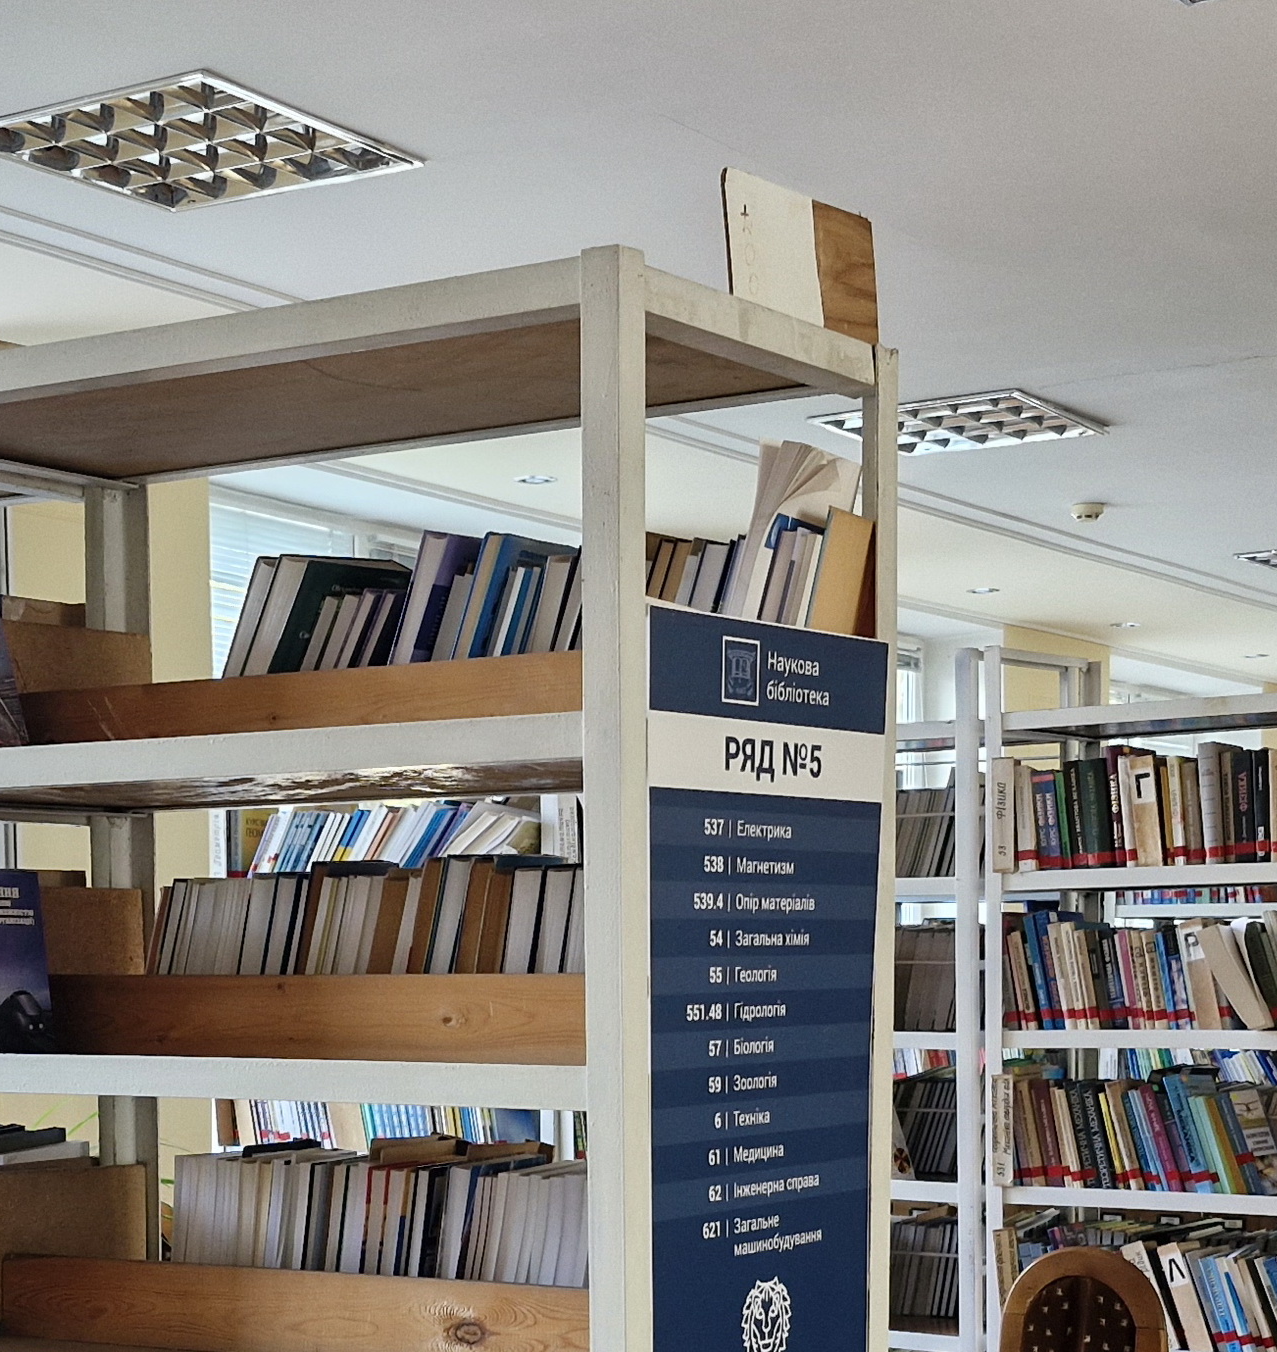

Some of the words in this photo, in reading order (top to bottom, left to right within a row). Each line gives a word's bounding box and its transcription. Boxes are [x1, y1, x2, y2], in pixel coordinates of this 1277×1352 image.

[767, 651, 820, 677] Наукова
[766, 683, 829, 707] бібліотека
[725, 736, 775, 782] РЯД
[782, 742, 822, 779] №5
[704, 819, 724, 835] 537
[737, 820, 792, 840] Електрика
[704, 856, 724, 873] 538
[736, 858, 794, 875] Магнетизм
[693, 892, 723, 910] 539.4
[736, 893, 759, 912] Опір
[761, 896, 815, 912] матеріалів
[709, 930, 723, 947] 54
[735, 930, 783, 947] Загальна
[784, 932, 810, 947] хімія
[709, 966, 723, 984] 55
[734, 966, 777, 985] Геологія
[686, 1003, 722, 1021] 551.48
[734, 1001, 786, 1021] Гідрологія
[708, 1040, 722, 1057] 57
[733, 1037, 774, 1057] Біологія
[708, 1077, 722, 1093] 59
[733, 1073, 777, 1091] Зоологія
[714, 1113, 722, 1128] 6
[733, 1108, 771, 1127] Техніка
[708, 1149, 721, 1166] 61
[733, 1143, 784, 1164] Медицина
[708, 1184, 722, 1202] 62
[733, 1178, 785, 1199] Інженерна
[786, 1174, 820, 1194] справа
[702, 1221, 721, 1239] 621
[733, 1215, 780, 1235] Загальне
[734, 1228, 822, 1257] машинобудування
